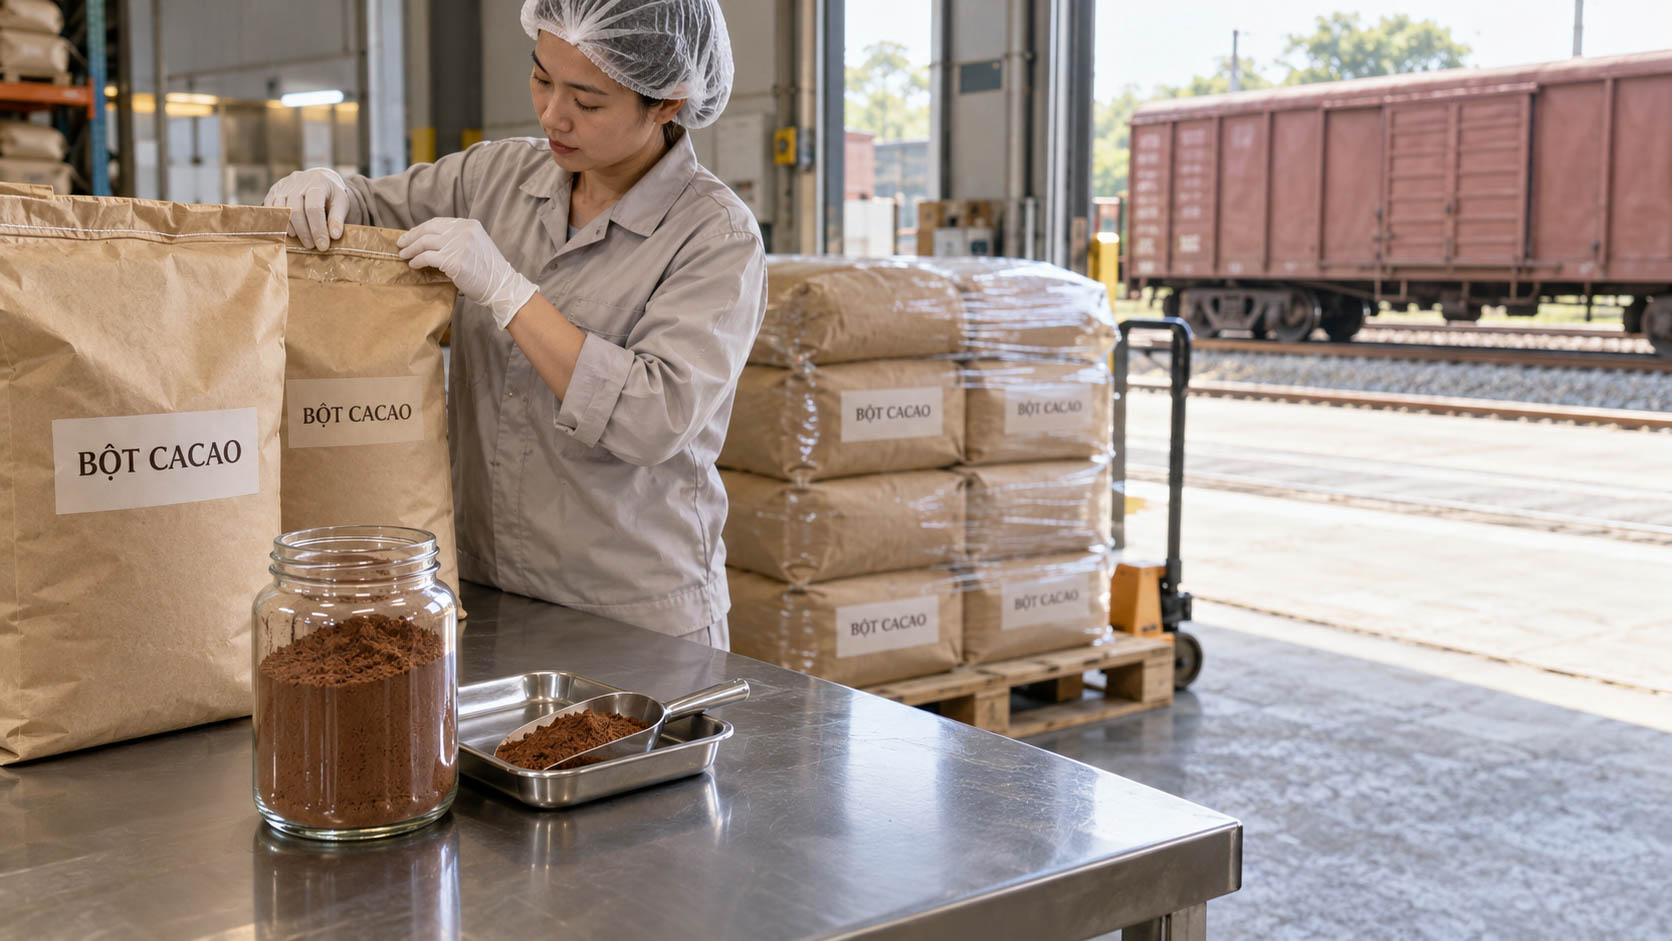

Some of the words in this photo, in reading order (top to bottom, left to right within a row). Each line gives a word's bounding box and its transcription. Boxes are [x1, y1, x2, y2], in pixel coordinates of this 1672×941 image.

[303, 402, 344, 428] BỘT
[348, 403, 412, 422] CACAO
[856, 404, 884, 424] BỘT
[887, 404, 932, 420] CACAO
[78, 443, 140, 481] BỘT
[149, 439, 242, 471] CACAO
[850, 617, 878, 638] BỘT
[881, 613, 927, 632] CACAO
